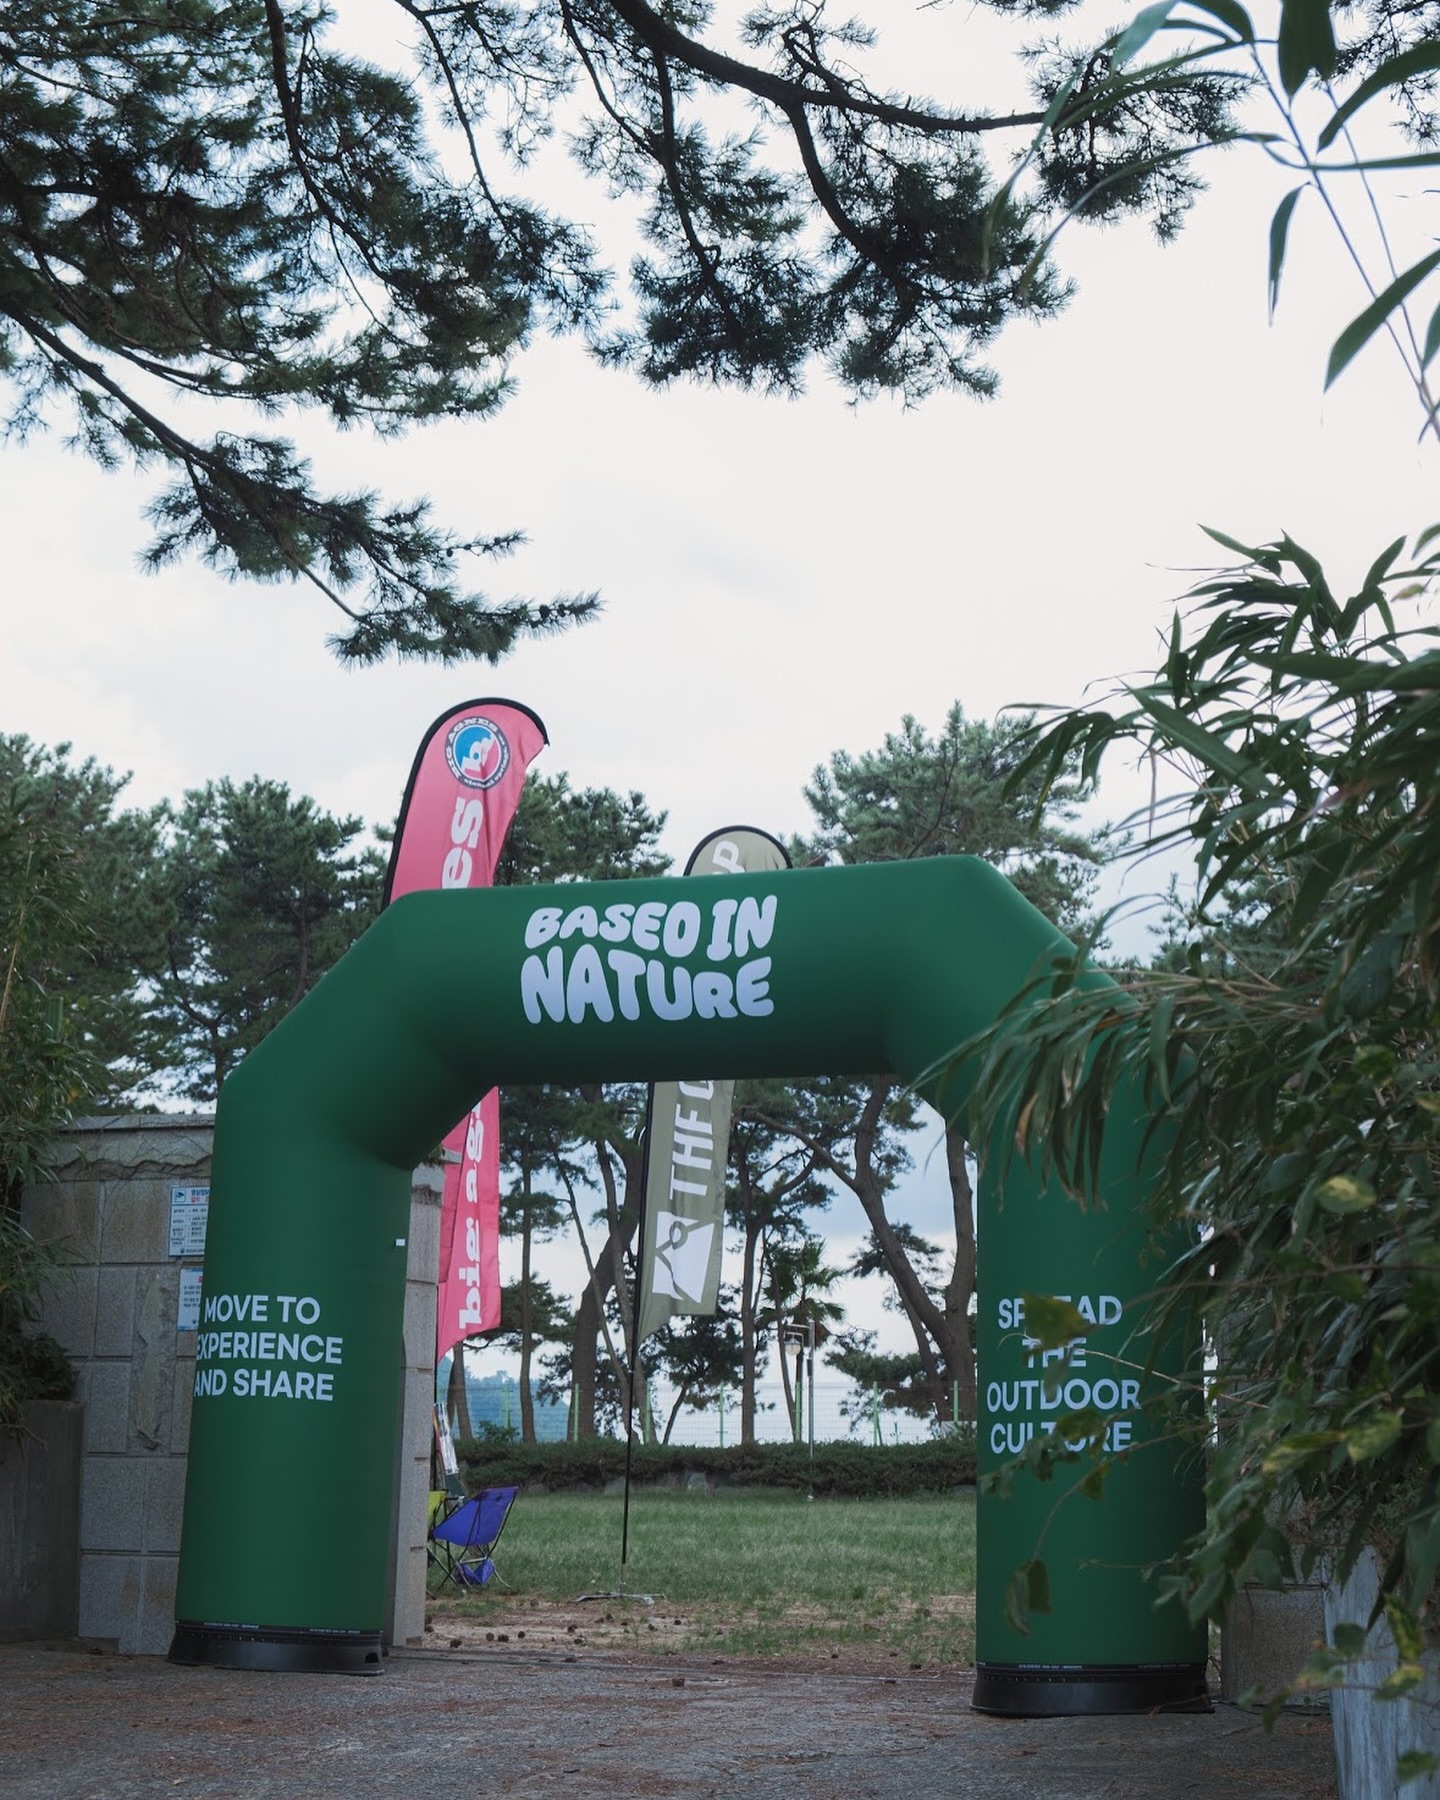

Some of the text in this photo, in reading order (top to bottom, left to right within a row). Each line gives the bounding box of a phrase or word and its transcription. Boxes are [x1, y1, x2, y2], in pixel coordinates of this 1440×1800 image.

[706, 894, 778, 962] IN
[520, 943, 774, 1024] NATURE
[458, 1217, 482, 1330] big
[204, 1294, 269, 1323] MOVE
[276, 1295, 321, 1325] TO
[997, 1295, 1123, 1329] SPAD
[196, 1331, 343, 1365] EXPERIENCE
[194, 1367, 335, 1402] AND SHARE
[986, 1377, 1142, 1413] OUTDOOR
